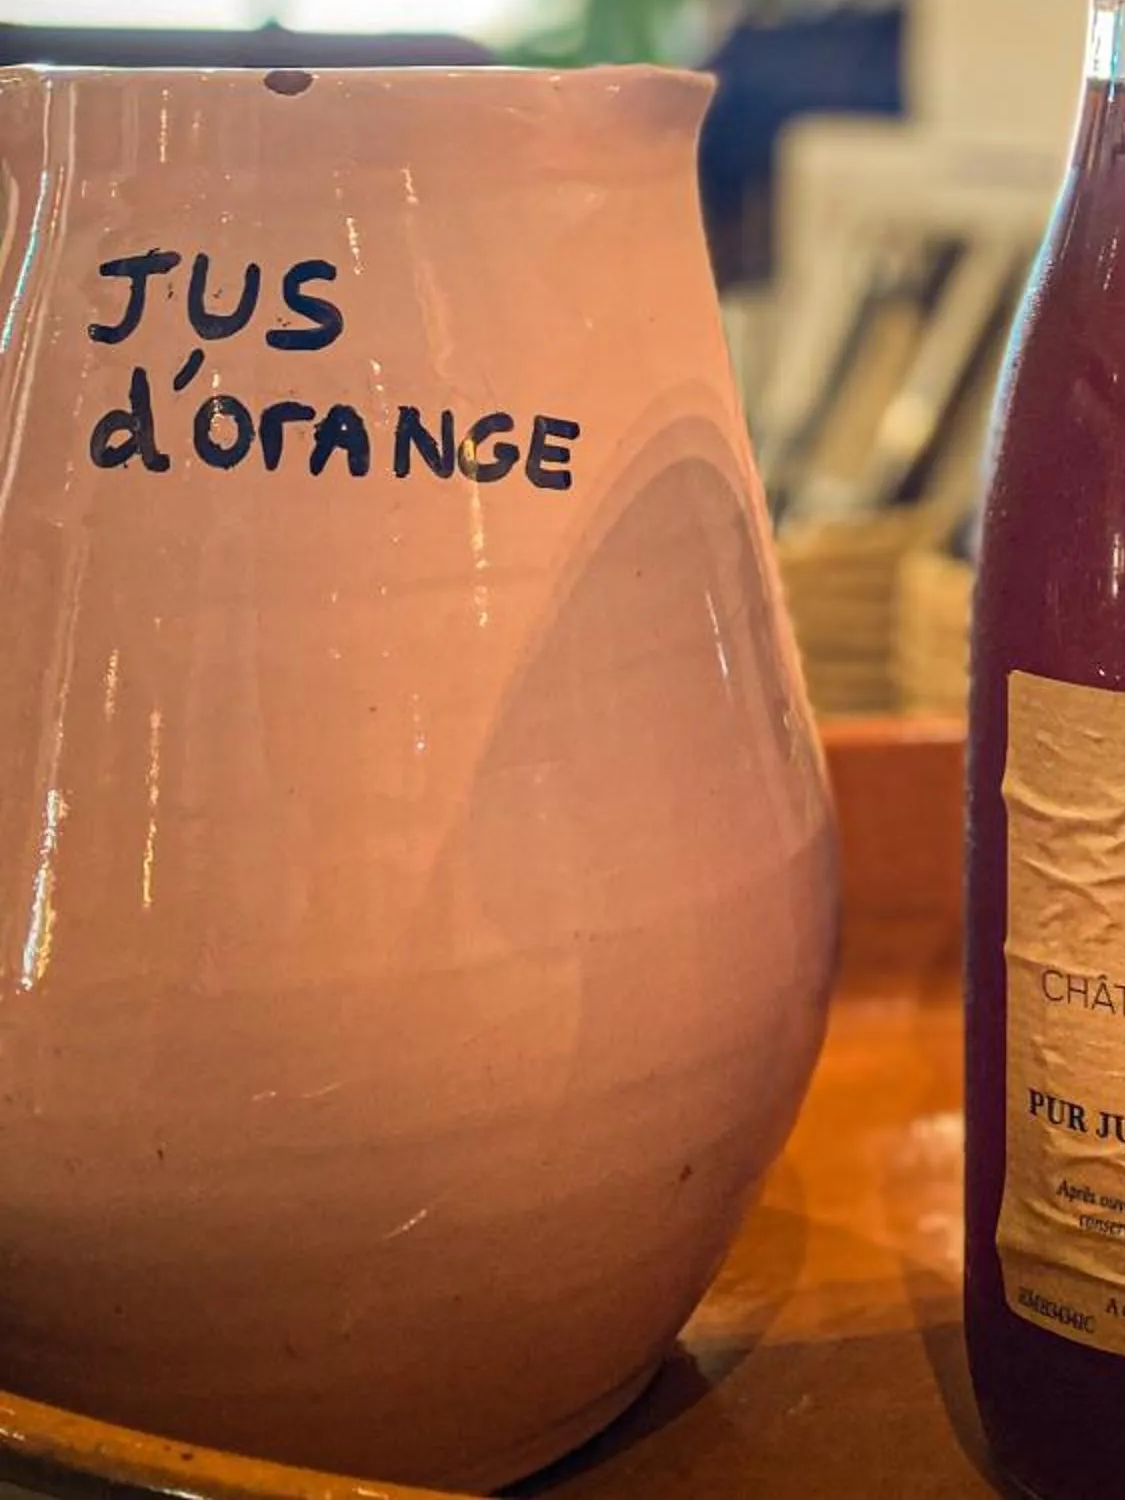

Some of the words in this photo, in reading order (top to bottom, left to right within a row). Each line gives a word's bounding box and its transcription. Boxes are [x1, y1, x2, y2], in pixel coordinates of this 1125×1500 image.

[88, 248, 344, 351] JUS
[1027, 1088, 1088, 1134] PUR
[1056, 1179, 1096, 1206] Après
[1106, 1297, 1120, 1316] A
